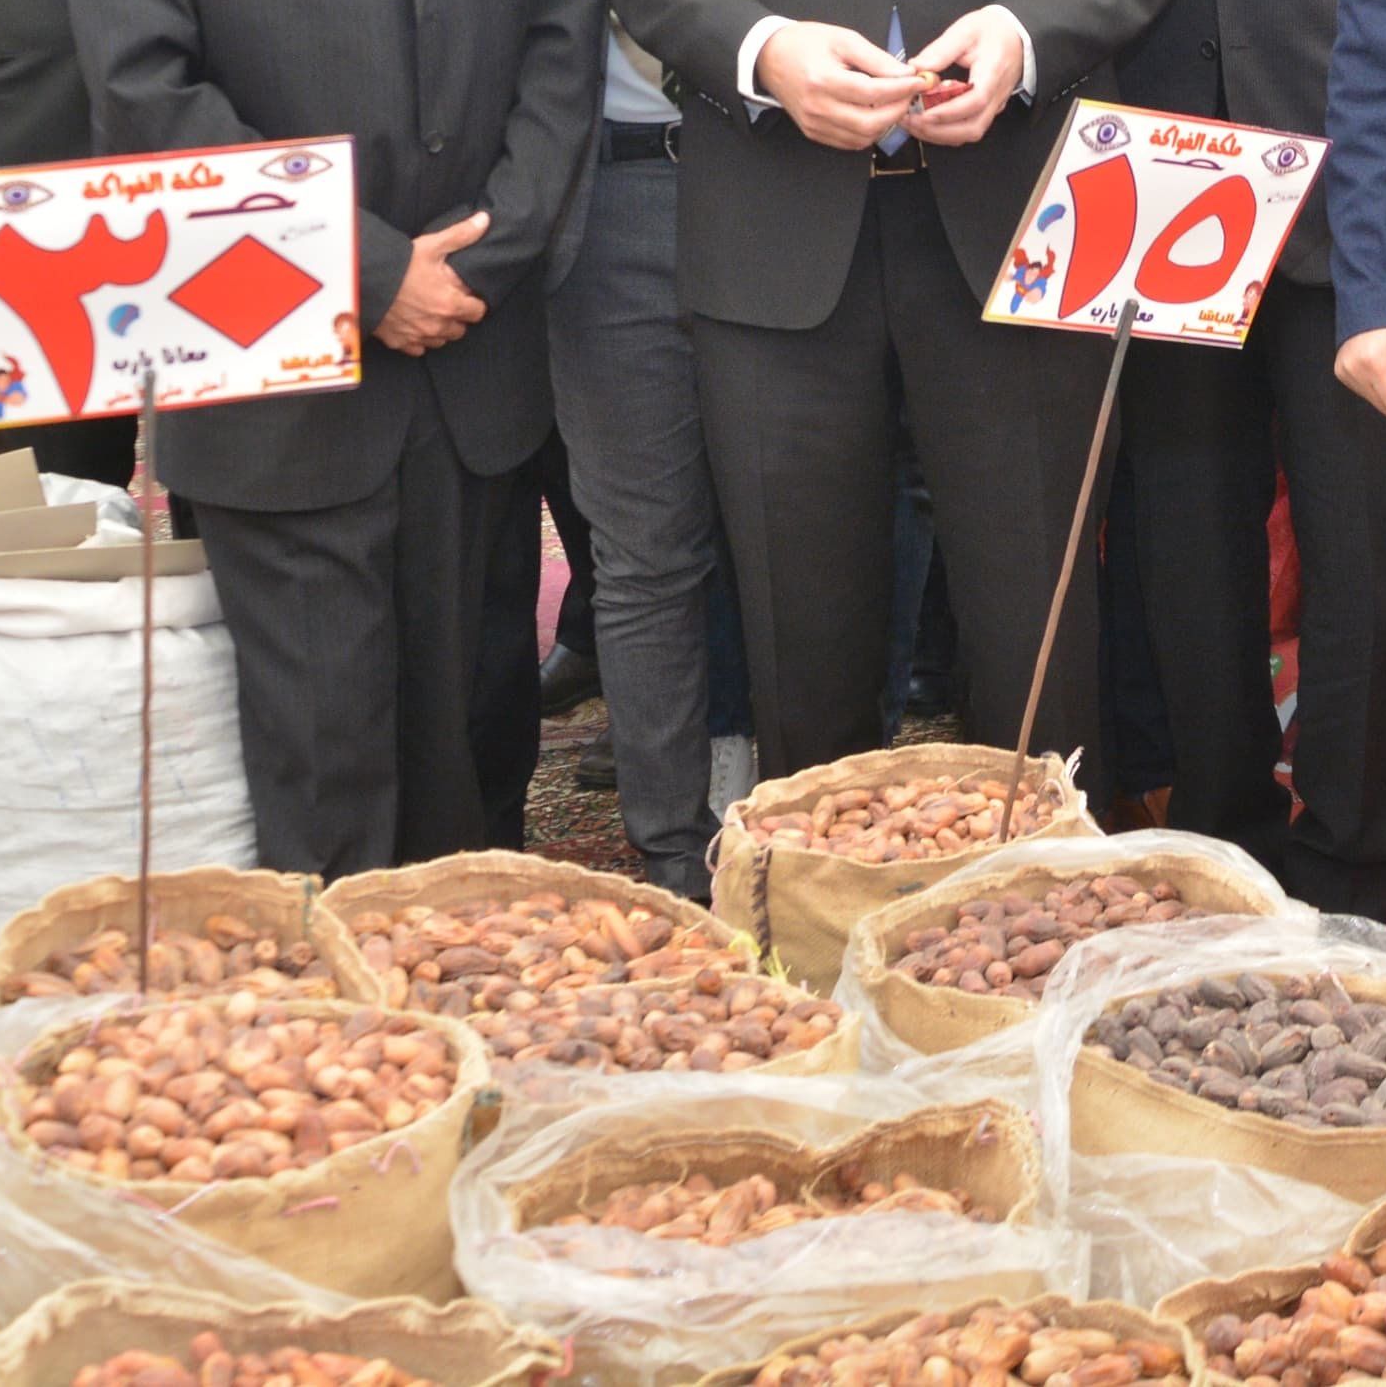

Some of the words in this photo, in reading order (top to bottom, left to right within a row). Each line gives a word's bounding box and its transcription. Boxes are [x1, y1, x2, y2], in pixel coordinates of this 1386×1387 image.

[1148, 123, 1205, 155] الفواكة
[1206, 132, 1243, 159] ملكة
[170, 162, 225, 190] ملكة
[1058, 153, 1258, 320] ١٥
